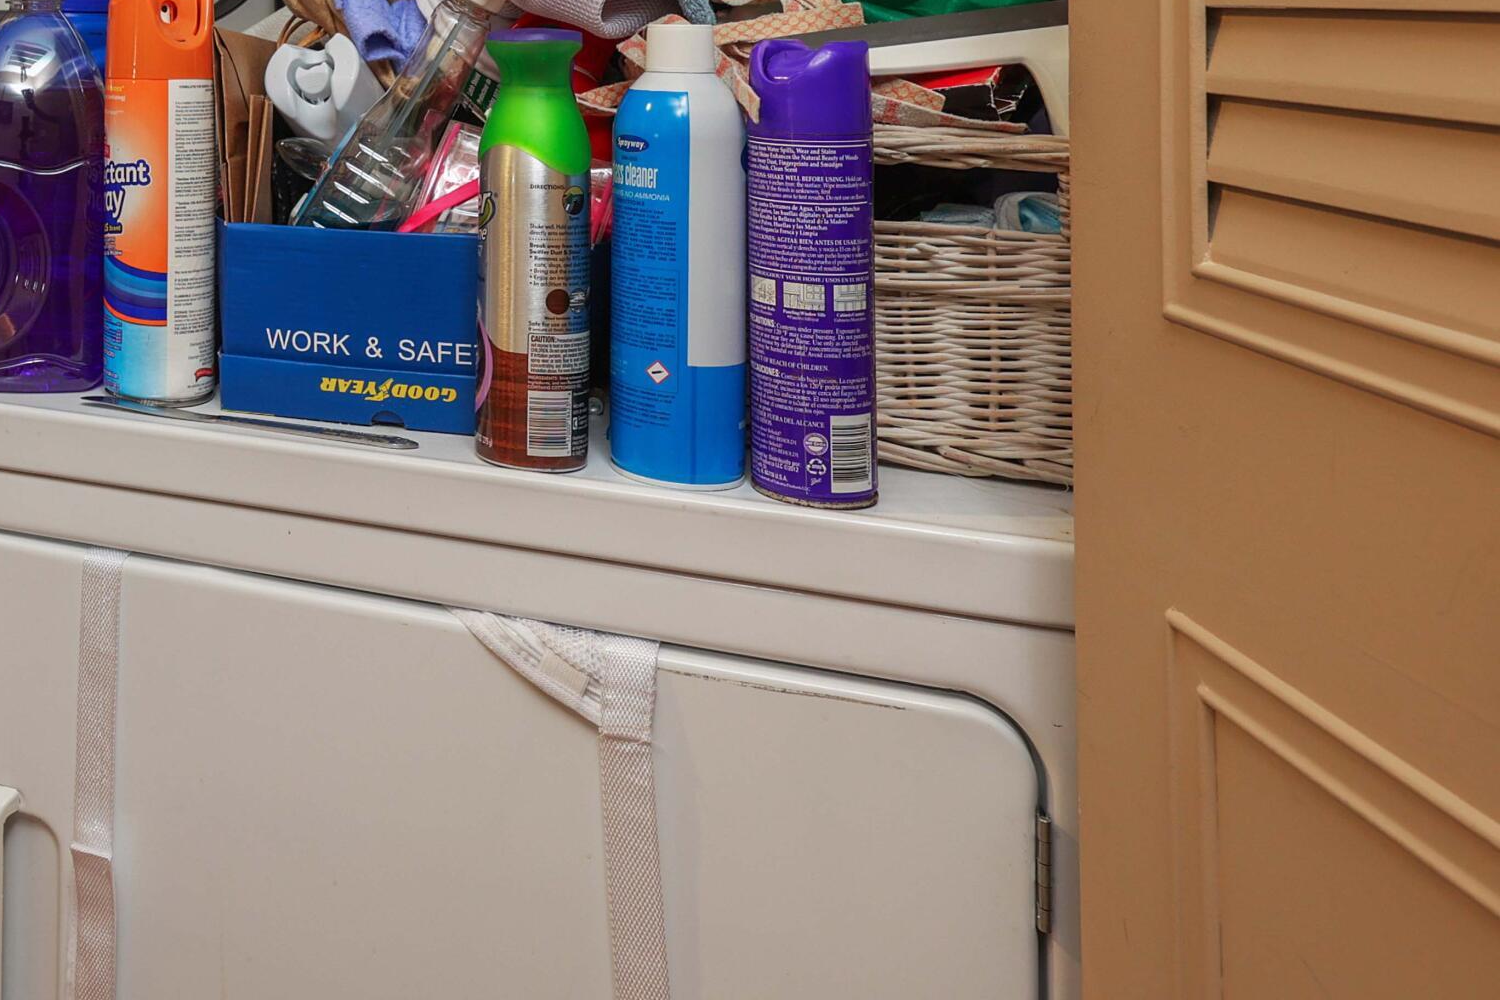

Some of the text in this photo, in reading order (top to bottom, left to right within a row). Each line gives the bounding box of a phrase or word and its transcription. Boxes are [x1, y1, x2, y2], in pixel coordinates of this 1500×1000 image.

[617, 136, 646, 151] Sprayway
[625, 161, 659, 189] cleaner
[106, 189, 124, 219] ay
[634, 191, 670, 202] AMMONIA
[265, 327, 351, 356] WORK
[365, 335, 383, 359] &
[320, 376, 457, 403] GOODYEAR
